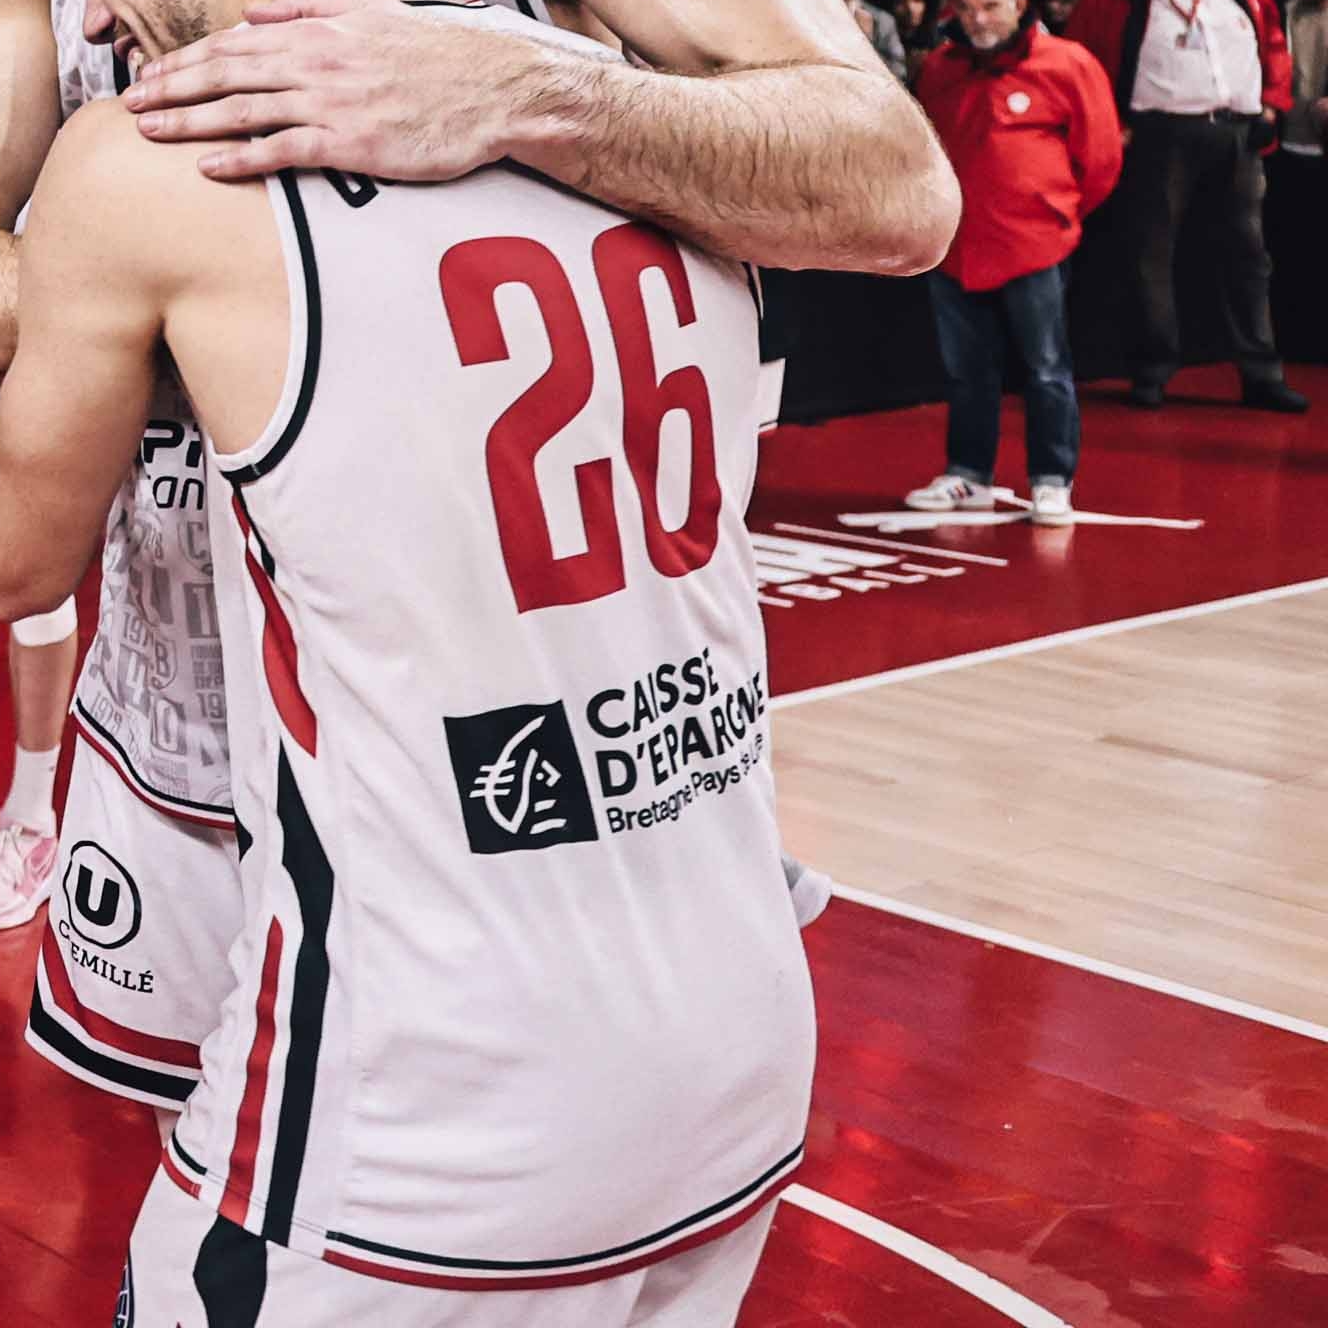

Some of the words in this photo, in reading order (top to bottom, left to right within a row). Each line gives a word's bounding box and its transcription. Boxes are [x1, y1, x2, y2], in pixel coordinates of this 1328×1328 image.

[438, 220, 722, 614] 26
[586, 646, 719, 739] CAISSE
[595, 672, 765, 799] D'EPARGNE
[606, 783, 694, 833] Bretagne
[692, 762, 741, 797] Pays
